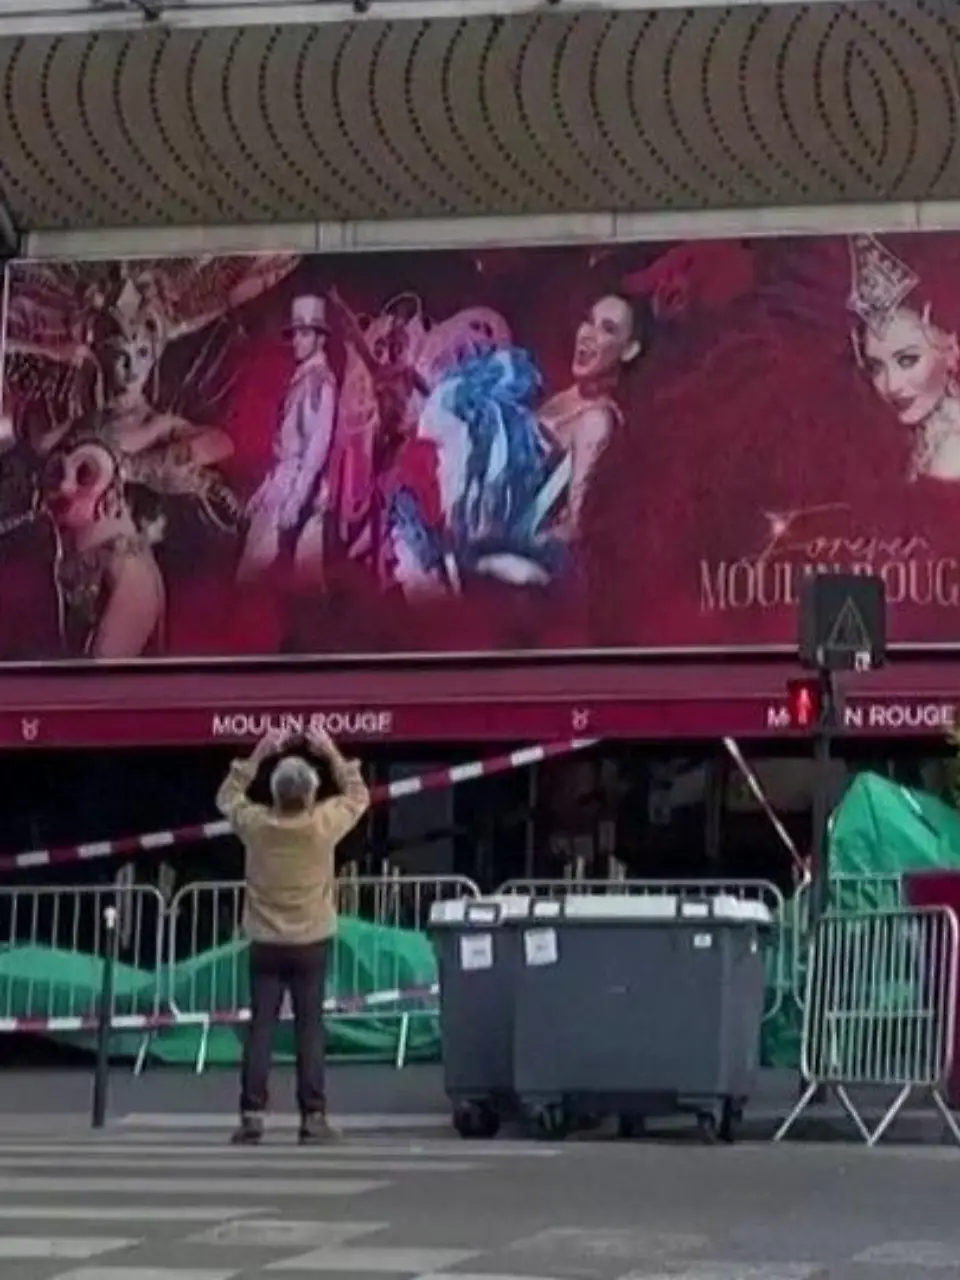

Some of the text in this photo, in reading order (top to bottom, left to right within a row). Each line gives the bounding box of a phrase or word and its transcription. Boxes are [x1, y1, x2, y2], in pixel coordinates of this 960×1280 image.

[700, 558, 842, 611] MOUL
[212, 714, 304, 736] MOULIN
[869, 705, 955, 727] ROUGE
